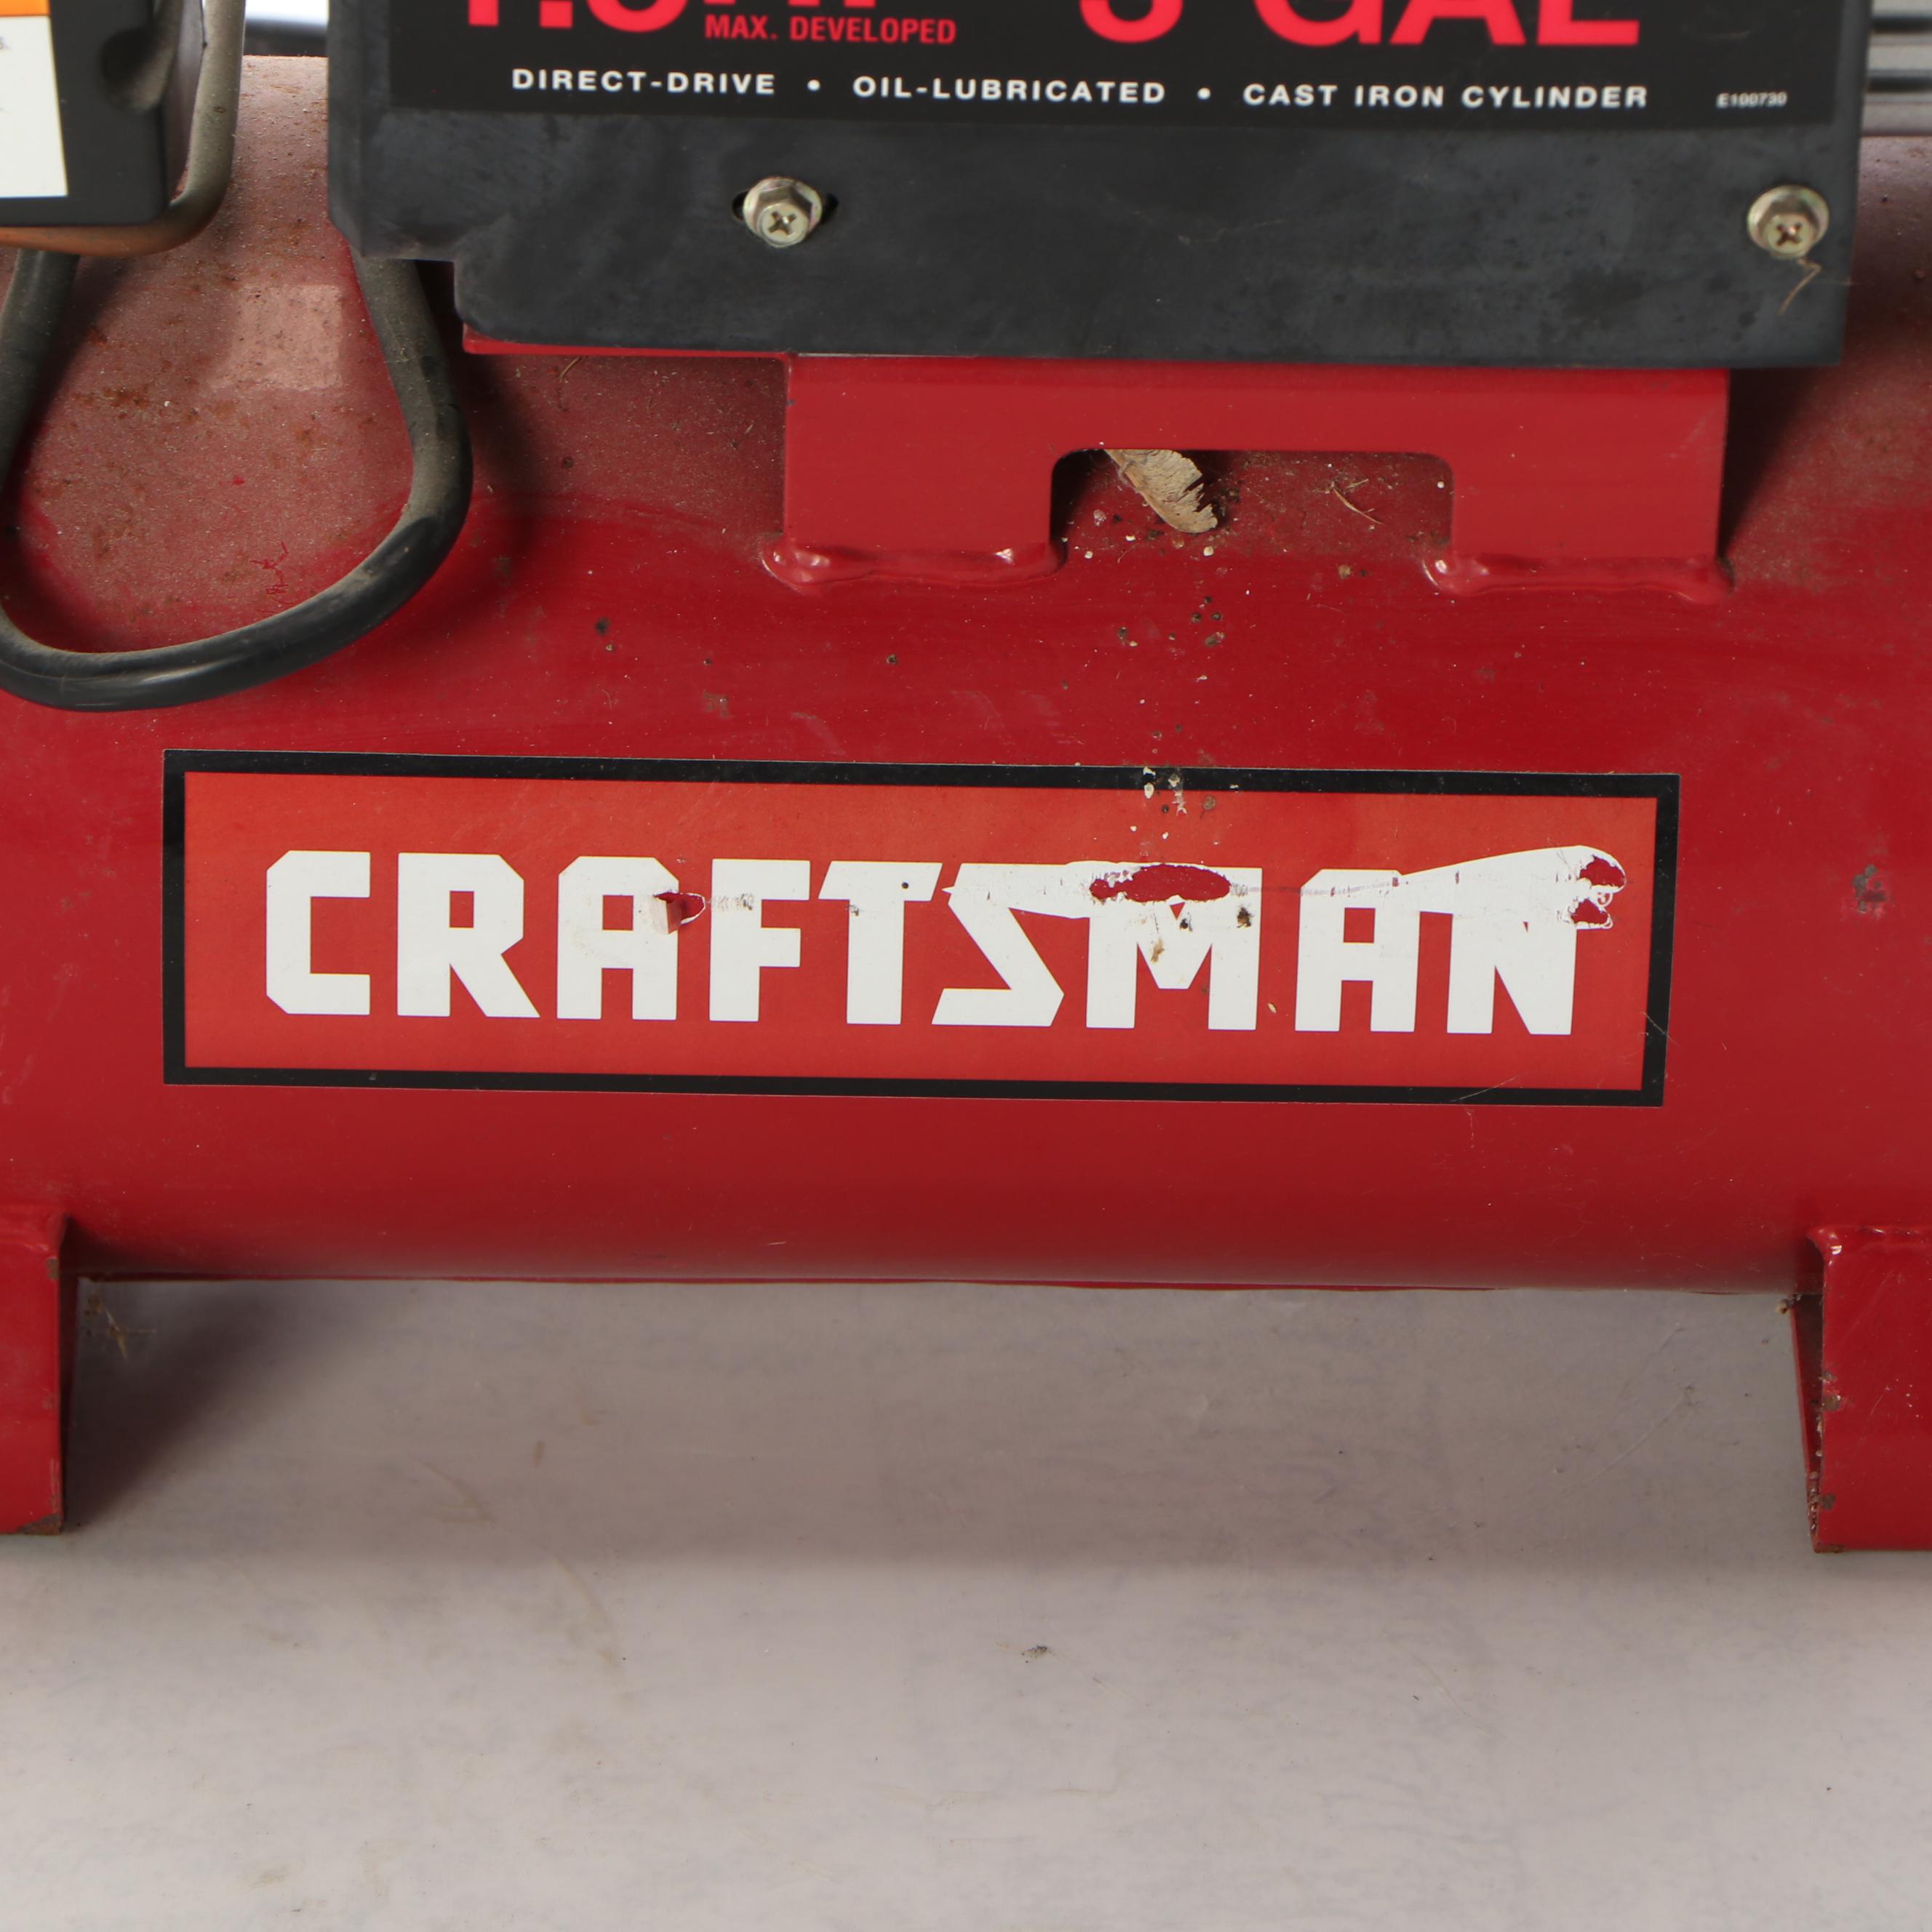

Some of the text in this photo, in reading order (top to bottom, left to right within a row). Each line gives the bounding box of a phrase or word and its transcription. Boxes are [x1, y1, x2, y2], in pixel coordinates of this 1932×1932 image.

[705, 14, 777, 40] MAX.
[790, 16, 957, 44] DEVELOPED
[512, 68, 1648, 109] DIRECT-DRIVE OIL-LUBRICATED CAST IRON CYLINDER
[1716, 91, 1788, 108] E100730
[266, 846, 1578, 1036] CRAFTSMAN
